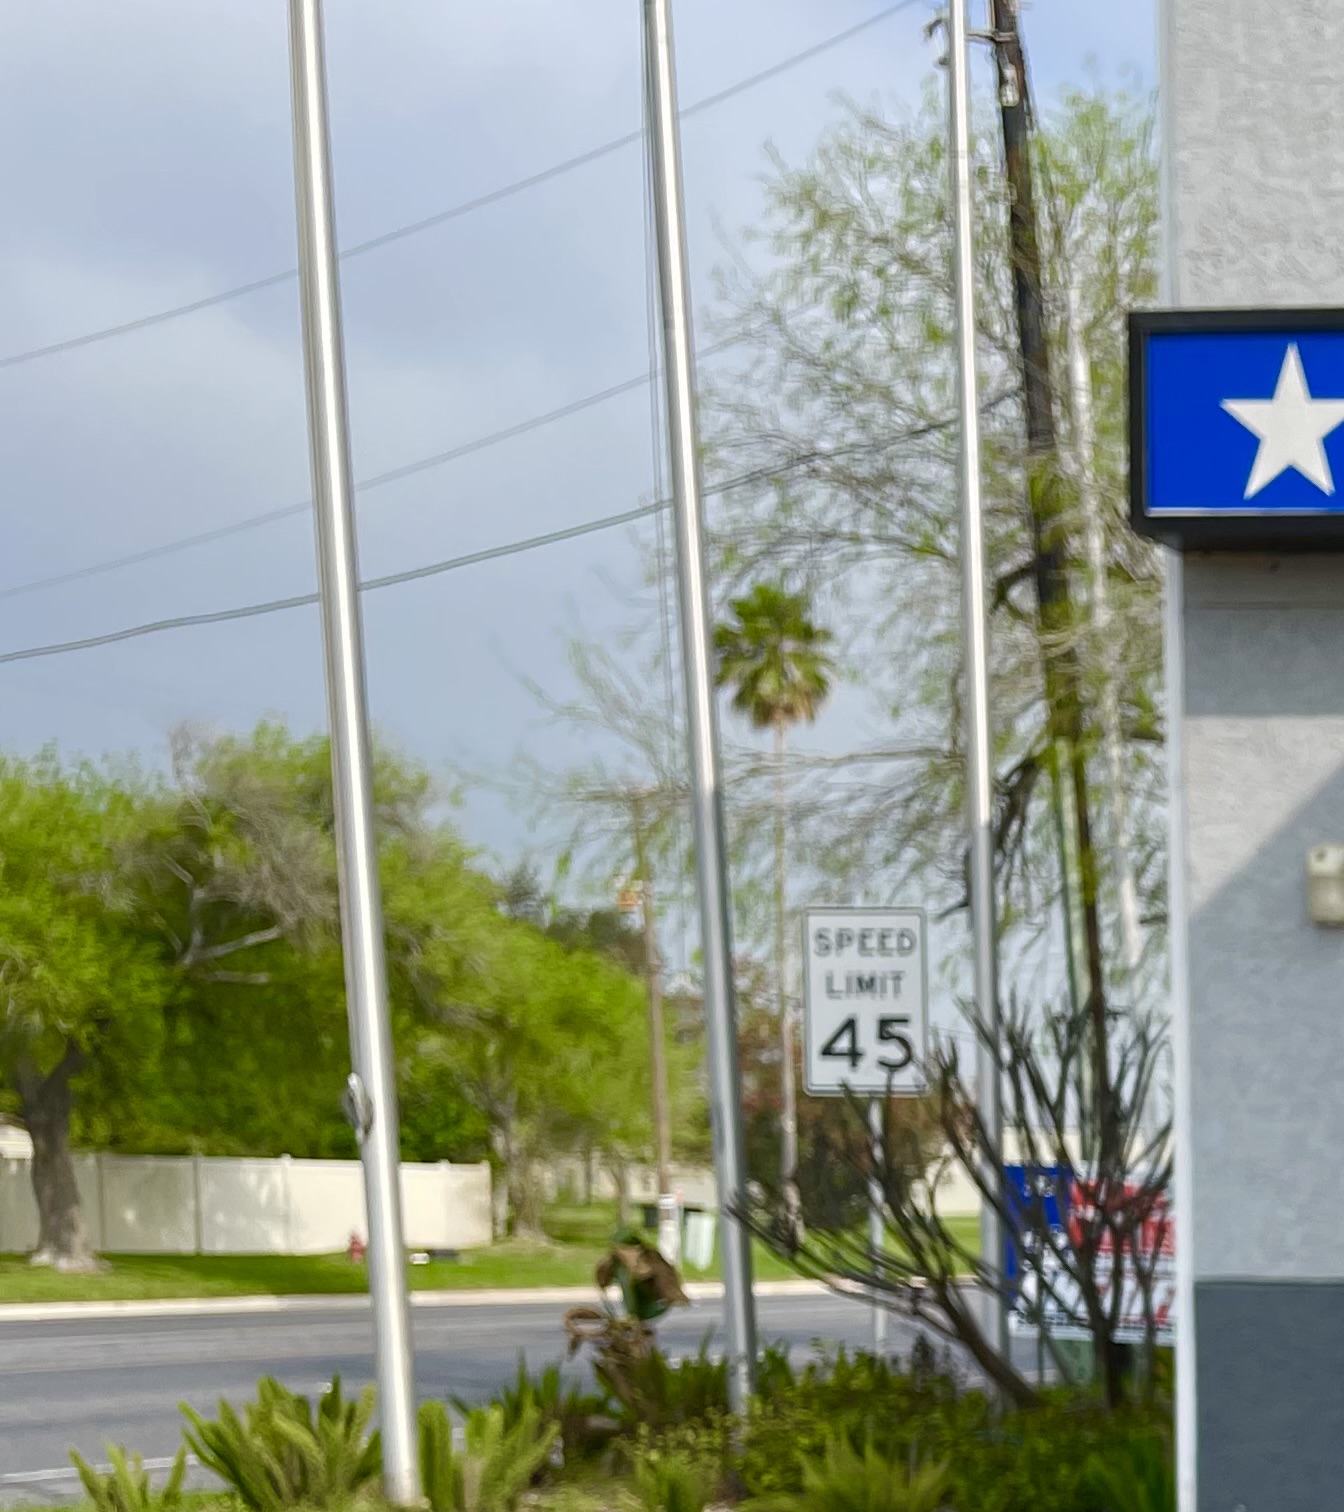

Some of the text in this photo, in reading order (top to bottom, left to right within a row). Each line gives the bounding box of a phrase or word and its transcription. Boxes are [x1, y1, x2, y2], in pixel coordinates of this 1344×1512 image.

[814, 927, 917, 957] SPEED
[825, 970, 905, 1000] LIMIT
[820, 1014, 914, 1070] 45
